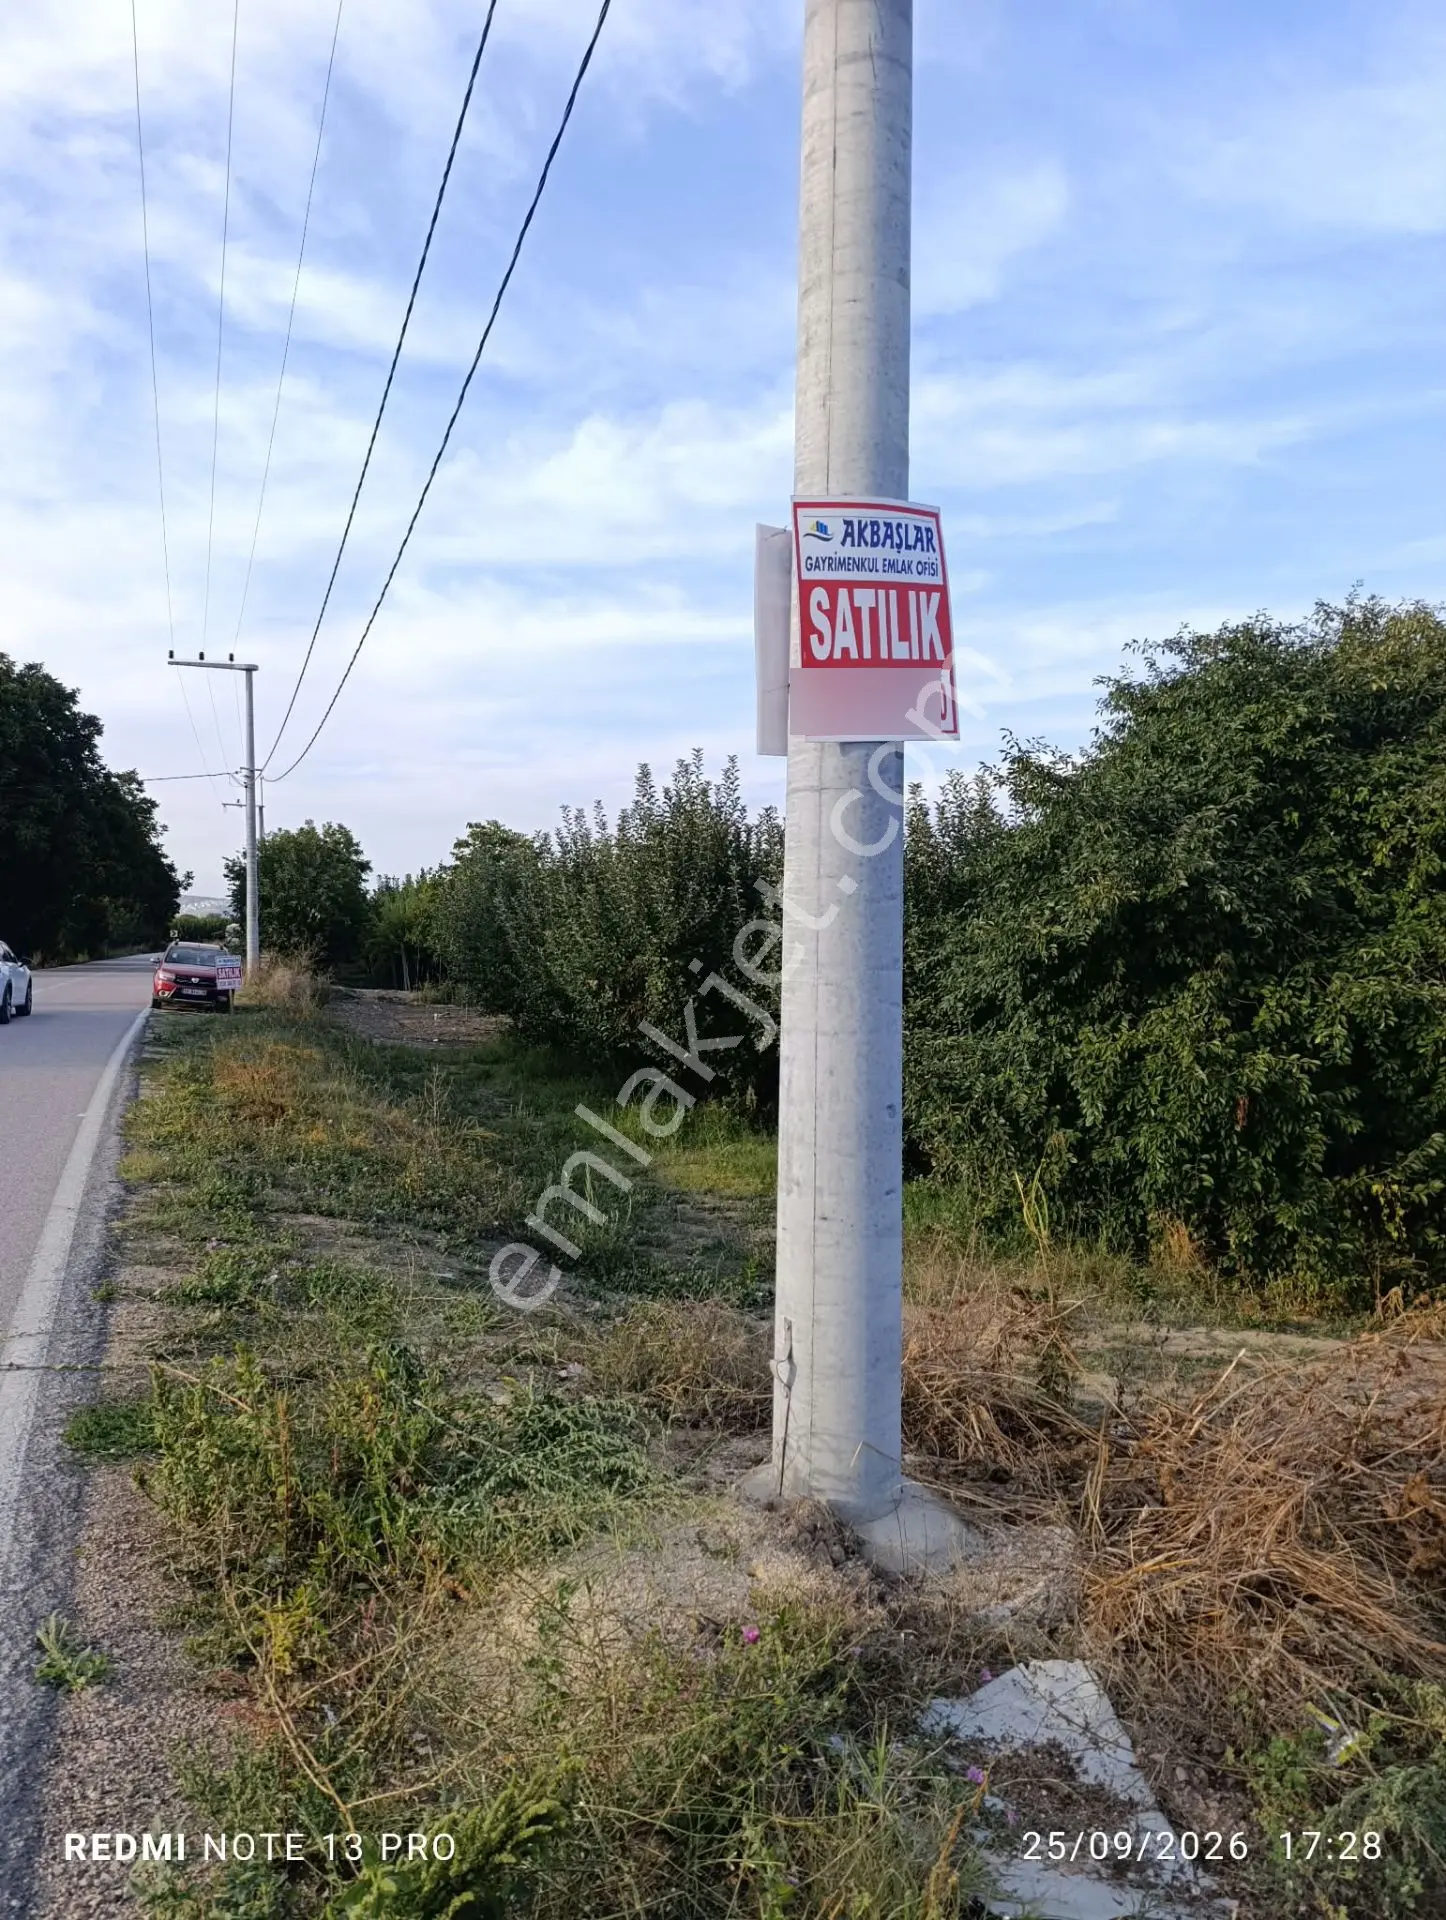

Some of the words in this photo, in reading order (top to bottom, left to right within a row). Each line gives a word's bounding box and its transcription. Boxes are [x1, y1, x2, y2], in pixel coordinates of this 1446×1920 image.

[841, 519, 936, 553] AKBAŞLAR
[805, 551, 880, 573] GAYRİMENKUL
[882, 559, 913, 576] EMLAK
[916, 556, 939, 577] OFİSİ
[809, 586, 945, 661] SATILIK
